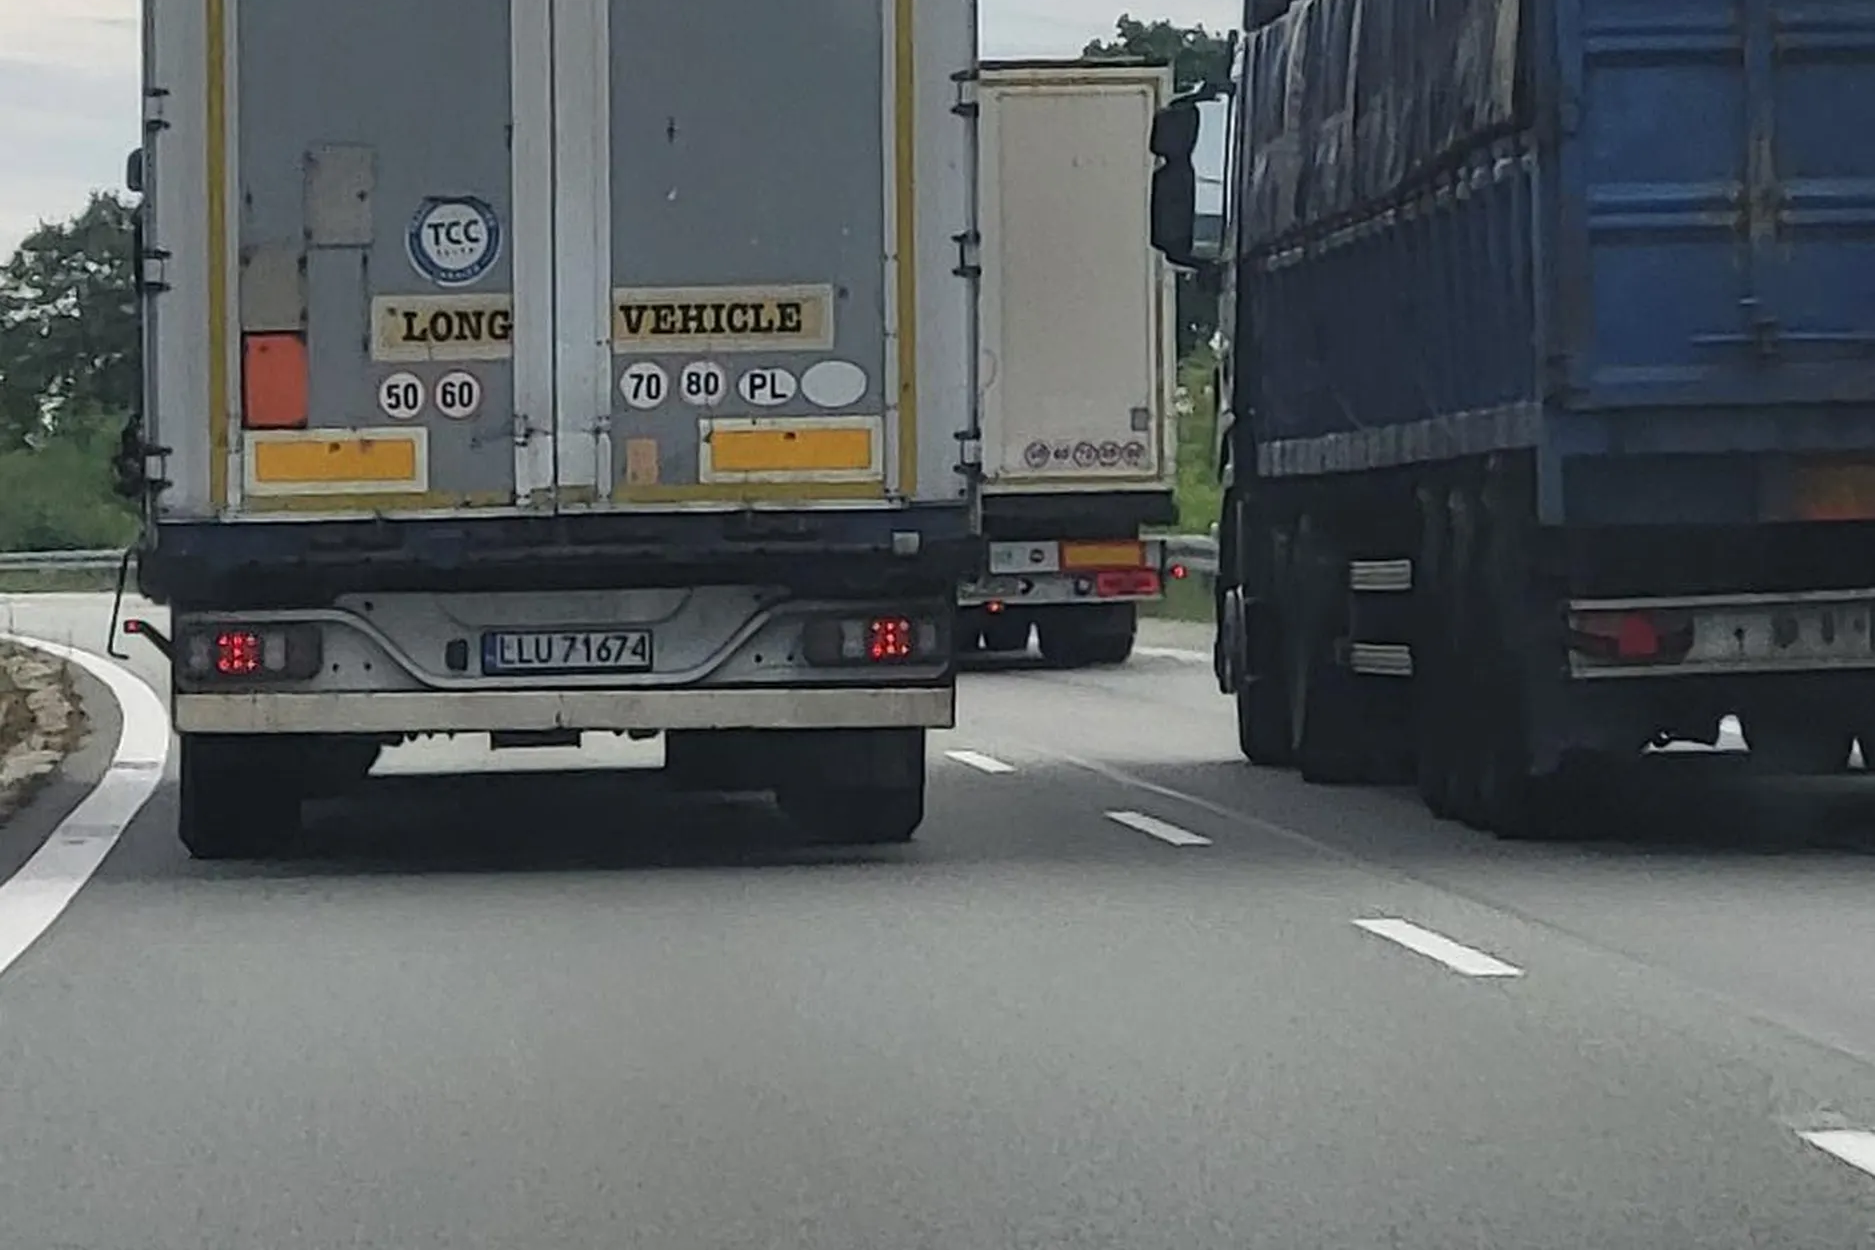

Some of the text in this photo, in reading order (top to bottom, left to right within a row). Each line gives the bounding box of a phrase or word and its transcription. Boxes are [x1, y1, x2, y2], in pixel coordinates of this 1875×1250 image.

[427, 219, 480, 246] TCC
[402, 303, 802, 342] LONG VEHICLE
[386, 382, 418, 410] 50
[441, 381, 473, 408] 60
[629, 372, 661, 400] 70
[686, 371, 719, 396] 80
[749, 372, 787, 400] PL
[562, 634, 648, 664] 71674
